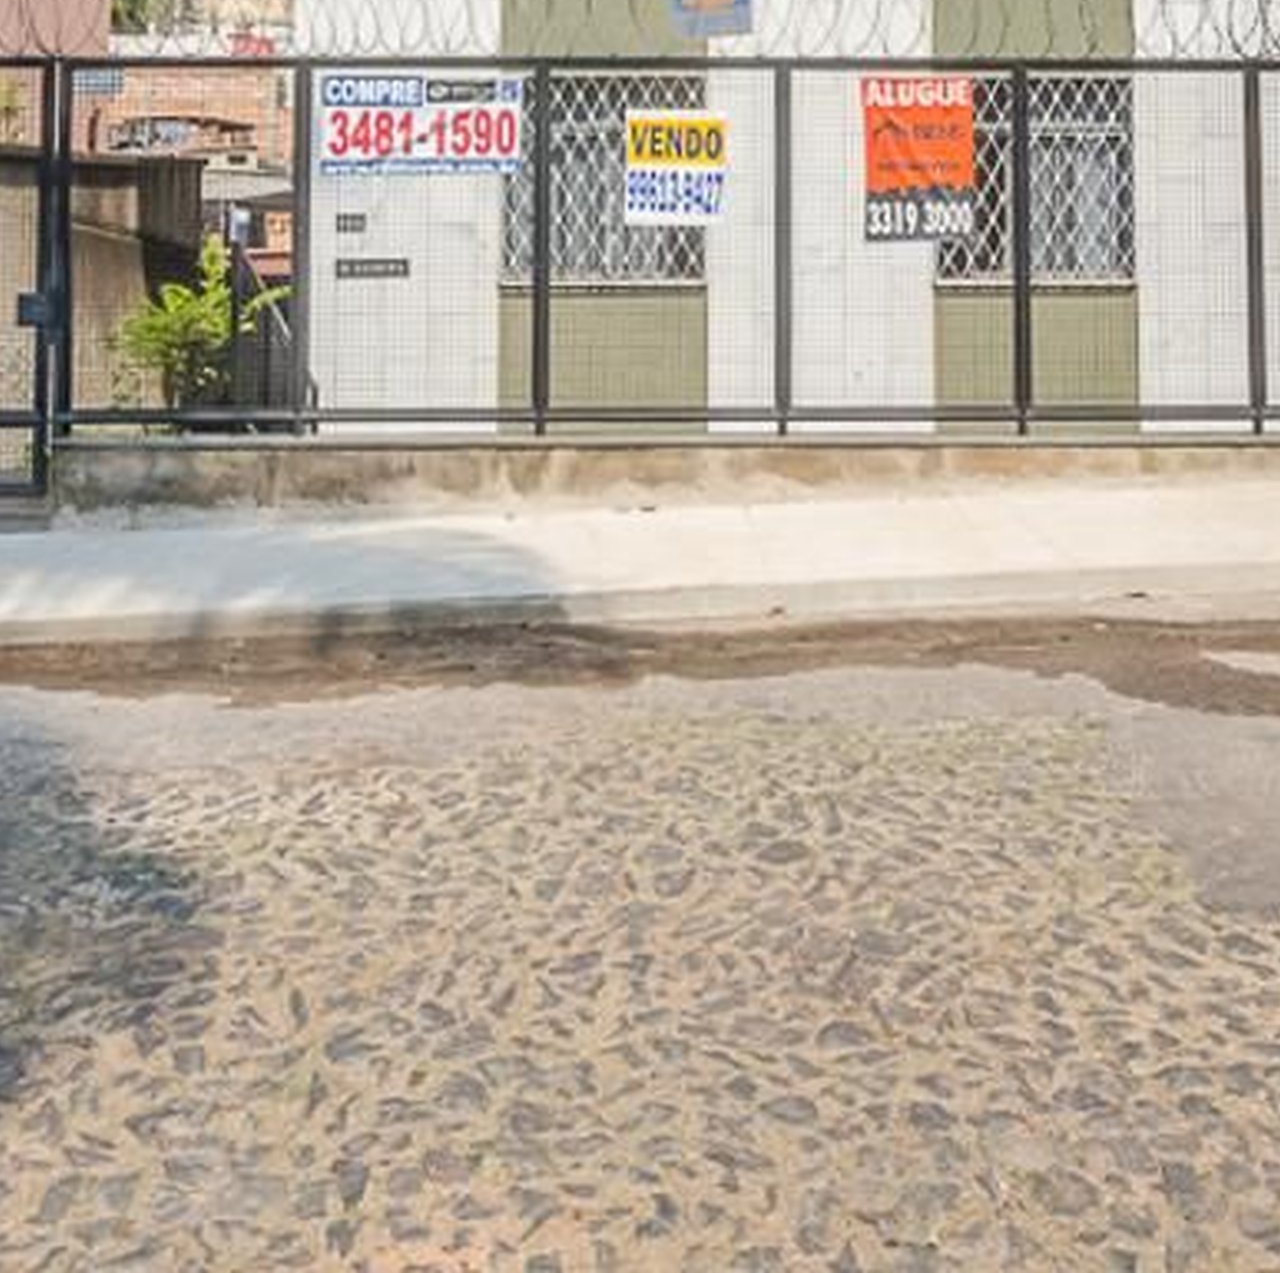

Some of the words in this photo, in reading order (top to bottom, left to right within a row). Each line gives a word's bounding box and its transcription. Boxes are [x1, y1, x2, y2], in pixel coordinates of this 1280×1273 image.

[324, 79, 421, 105] COMPRE
[867, 79, 970, 107] ALUGUE
[328, 110, 516, 156] 3481-1590
[629, 125, 723, 159] VENDO
[868, 200, 918, 235] 3319
